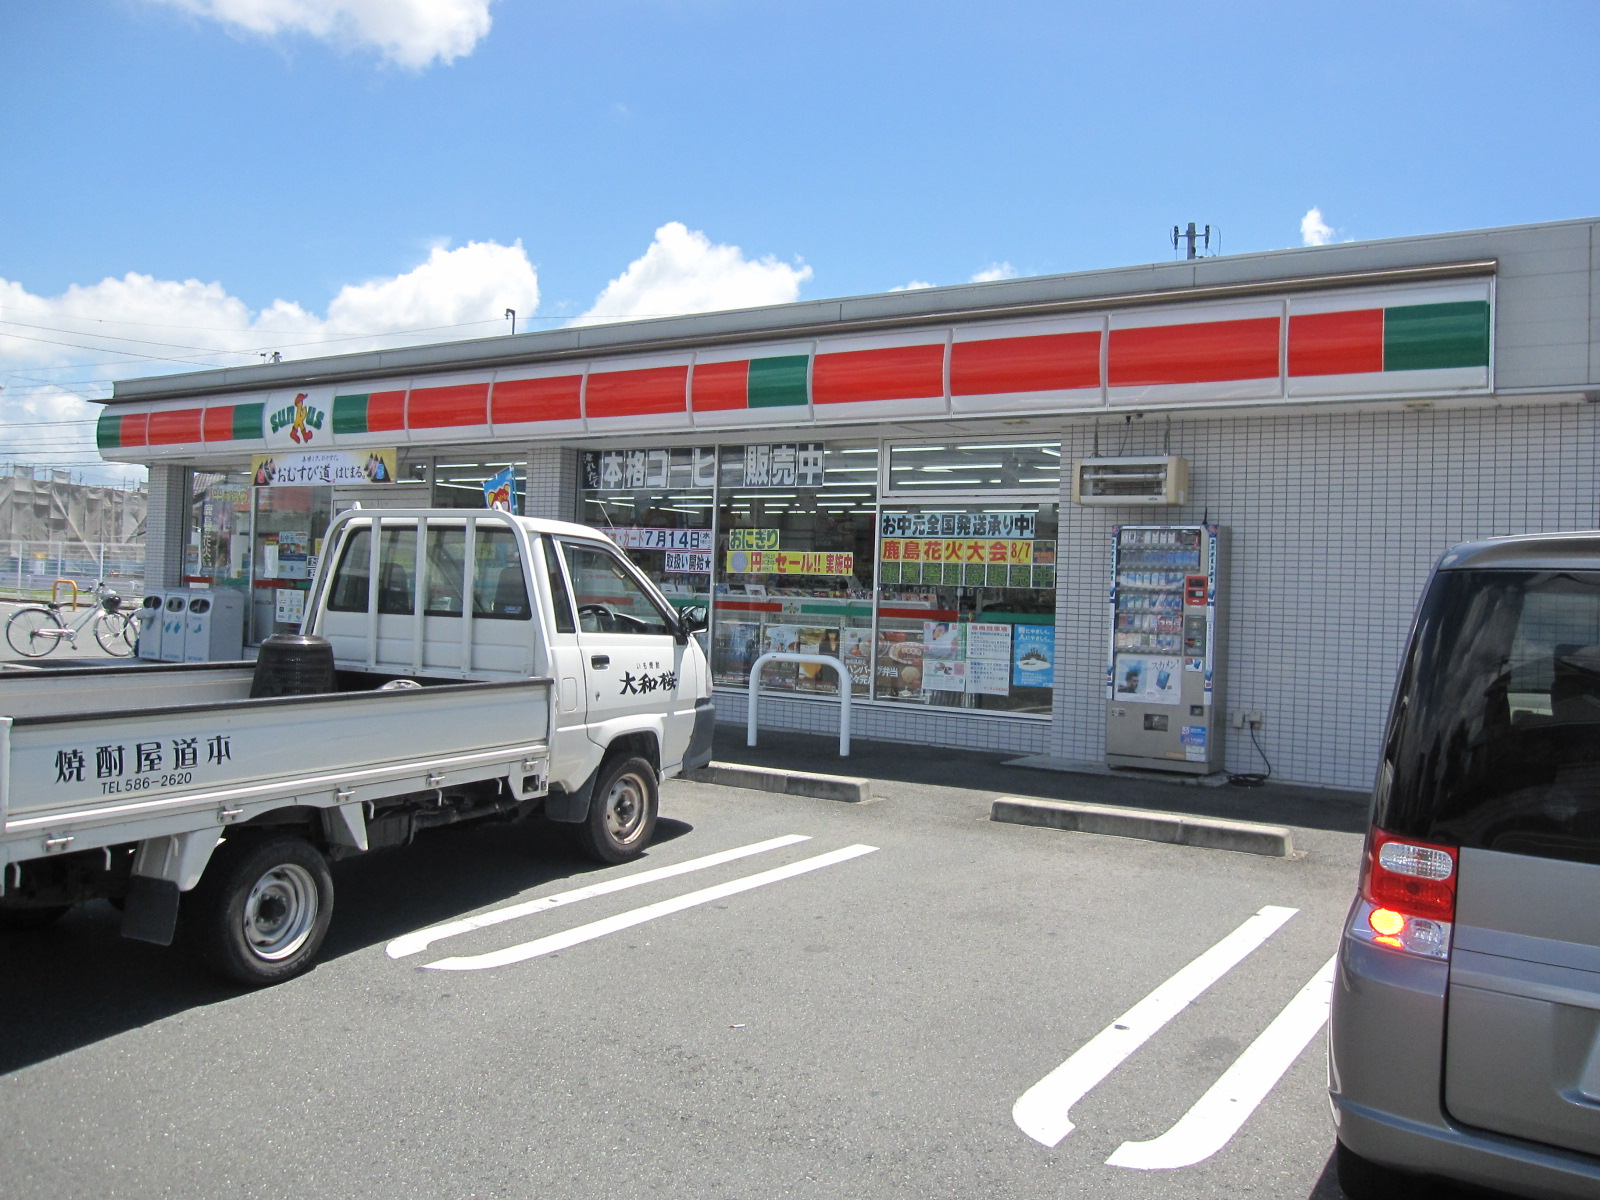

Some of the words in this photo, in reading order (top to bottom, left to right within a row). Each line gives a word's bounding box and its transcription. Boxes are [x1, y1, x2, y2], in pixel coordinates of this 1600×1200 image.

[277, 464, 331, 483] おむすび道
[882, 514, 1034, 536] お中元全国発送承り中!
[730, 529, 778, 549] おにぎり
[619, 670, 678, 695] 大和桜
[125, 772, 192, 792] 586-2620
